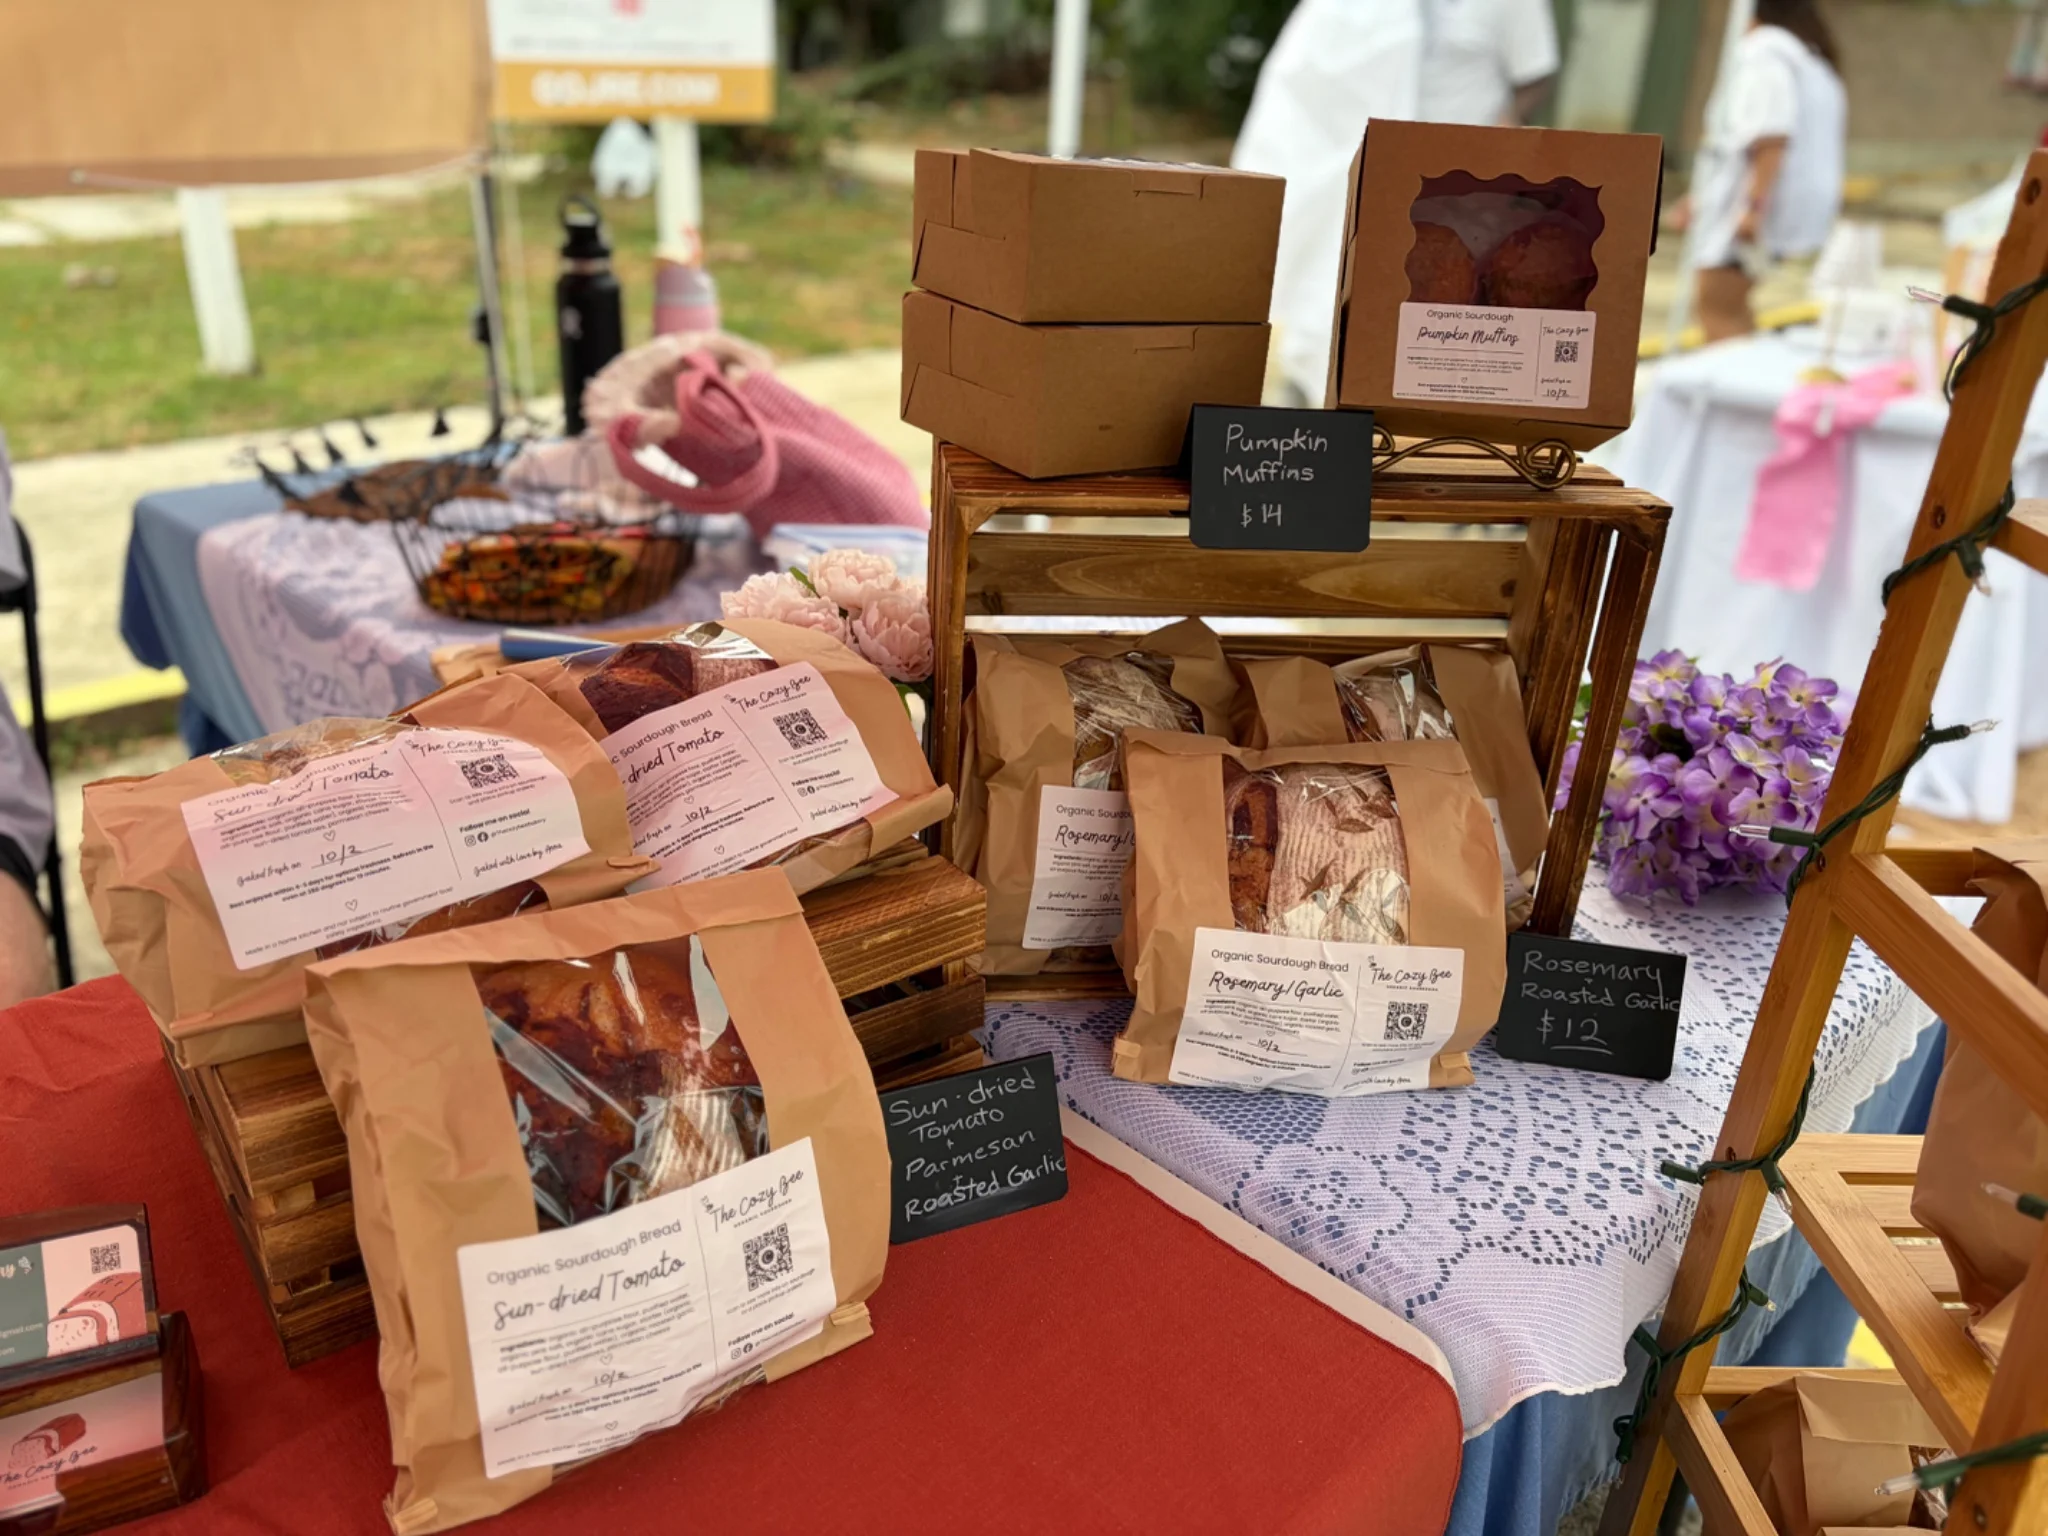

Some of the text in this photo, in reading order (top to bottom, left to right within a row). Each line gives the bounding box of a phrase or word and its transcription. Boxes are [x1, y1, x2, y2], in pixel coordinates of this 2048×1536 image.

[1426, 309, 1514, 322] Organic Sourdough
[1417, 326, 1519, 346] Pumpkin Muffins
[1542, 326, 1554, 335] The
[1555, 327, 1575, 337] Cozy
[1546, 389, 1568, 401] 10/2
[1226, 424, 1328, 461] Pumpkin
[1223, 460, 1315, 486] Muffins
[736, 675, 812, 714] The Cozy Bee
[621, 724, 679, 759] Sourdough
[678, 709, 713, 731] Bread
[418, 741, 444, 757] The
[622, 753, 665, 787] -dried
[664, 728, 725, 763] Tomato
[319, 762, 394, 791] Tomato
[685, 805, 713, 823] 10/2
[1056, 804, 1134, 819] Organic Sourdo
[319, 843, 365, 866] 10/2
[1211, 949, 1349, 973] Organic Sourdough Bread
[1523, 950, 1664, 1000] Rosemary
[1208, 970, 1344, 1001] Rosemary/Garlic
[1370, 966, 1453, 988] The Cozy Bee
[1521, 982, 1681, 1012] Roasted Garlic
[1255, 1038, 1281, 1052] 10/2
[908, 1107, 1004, 1143] Tomato
[906, 1130, 1036, 1181] Parmesan
[711, 1168, 804, 1233] The Cozy Bee
[905, 1154, 1067, 1222] Roasted Garlic
[486, 1219, 682, 1286] Organic Sourdough Bread
[493, 1277, 602, 1331] Sun-dried
[609, 1251, 686, 1299] Tomato
